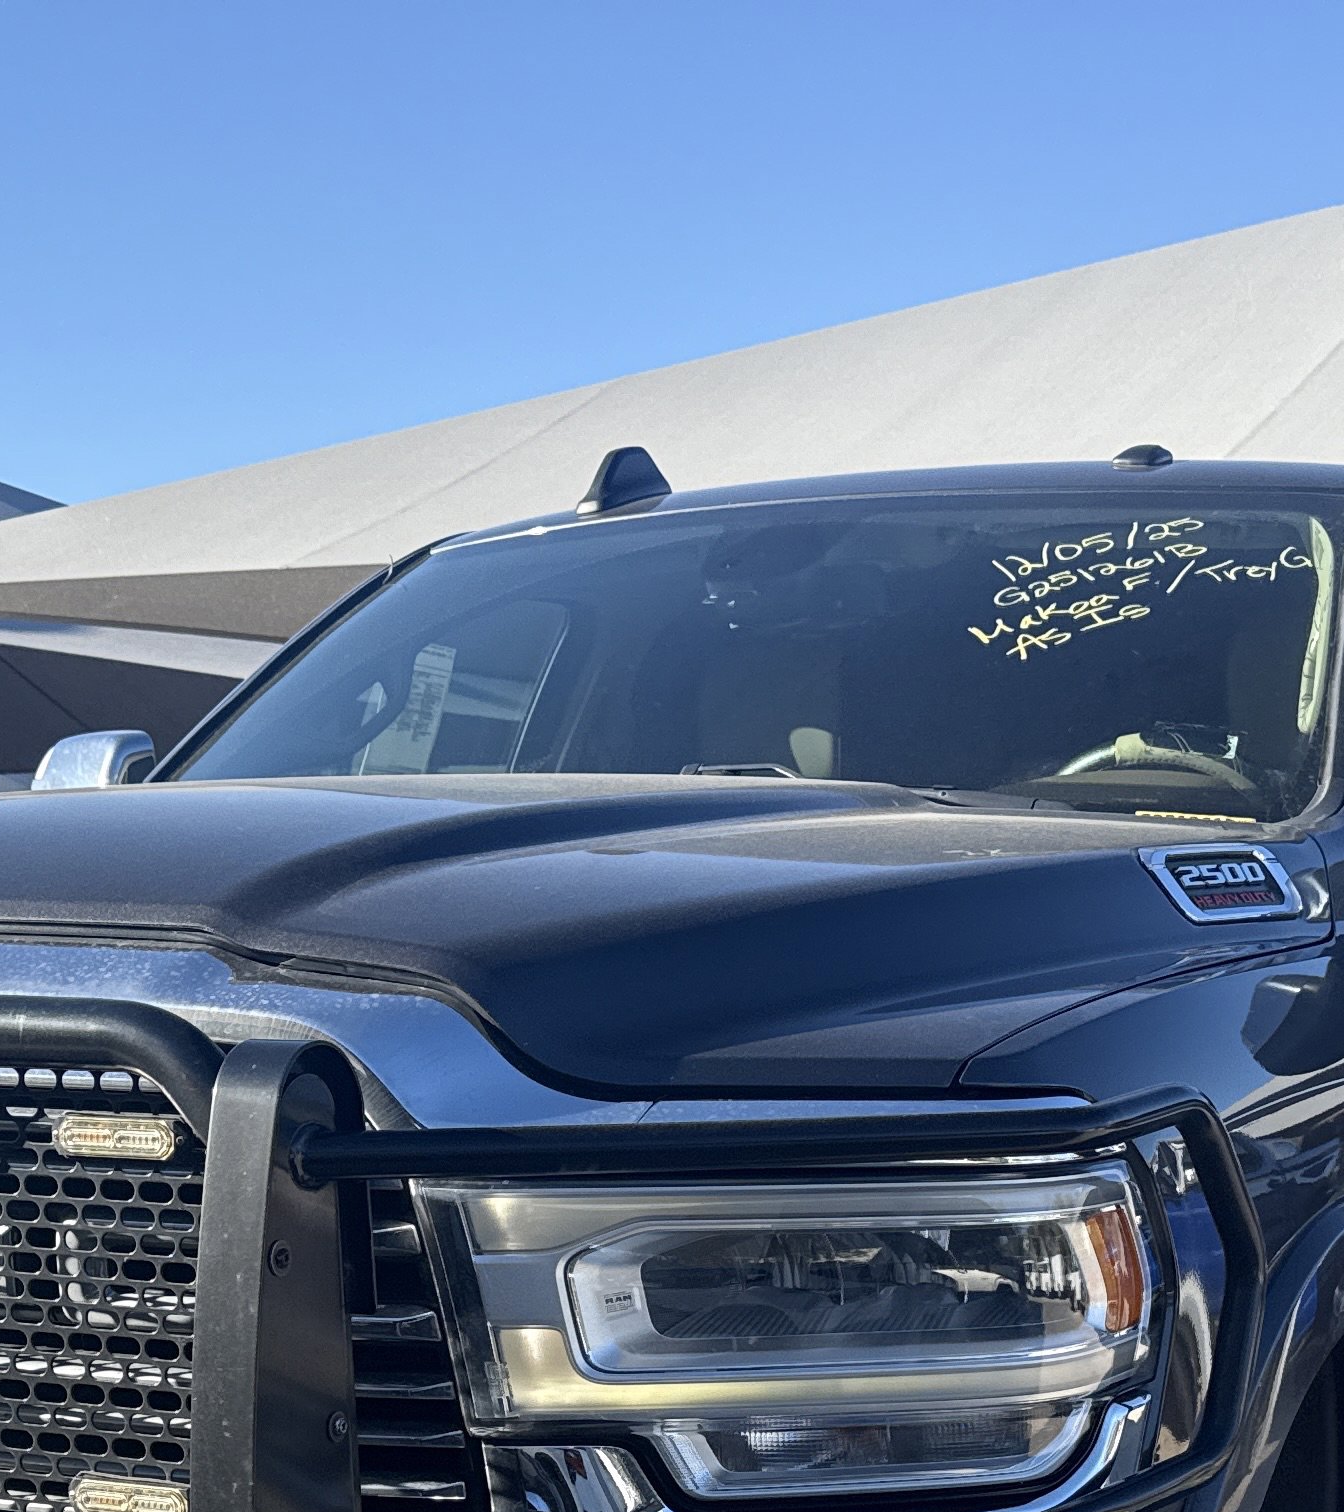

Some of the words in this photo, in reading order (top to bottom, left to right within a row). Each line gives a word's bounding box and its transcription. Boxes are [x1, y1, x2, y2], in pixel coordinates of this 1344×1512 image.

[992, 517, 1205, 582] 12/05/25
[1174, 862, 1266, 888] 2500
[1193, 893, 1240, 909] HEAVY
[1240, 890, 1277, 905] DUTY
